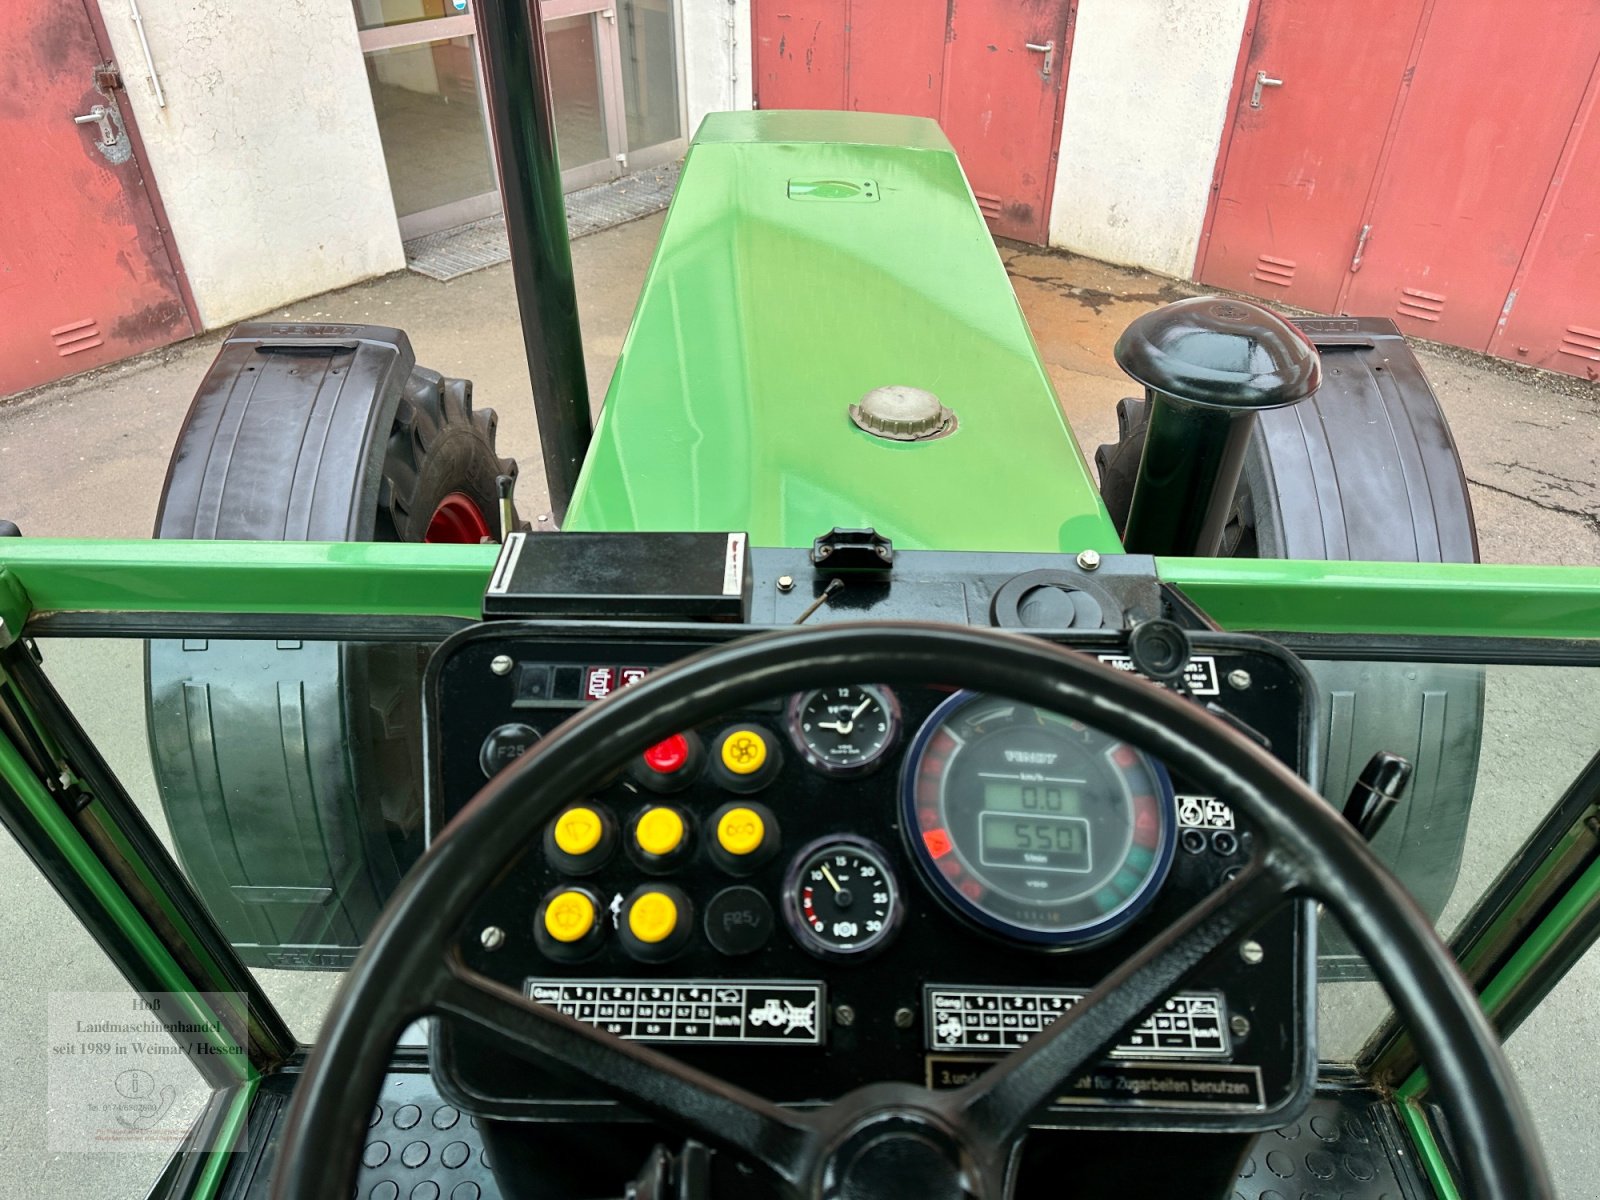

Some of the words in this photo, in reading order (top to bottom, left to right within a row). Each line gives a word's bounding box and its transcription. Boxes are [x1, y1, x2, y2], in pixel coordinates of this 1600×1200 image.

[271, 324, 364, 335] FENDT
[838, 688, 850, 697] 12
[803, 723, 811, 732] 9
[878, 723, 886, 732] 3
[497, 744, 525, 758] F25
[1020, 772, 1044, 781] km/h
[1021, 786, 1062, 811] 0.0
[1015, 824, 1073, 850] 550
[835, 856, 847, 866] 15
[810, 870, 823, 880] 10
[860, 867, 876, 877] 20
[804, 898, 812, 908] 5
[873, 893, 888, 903] 25
[815, 921, 824, 932] 0
[866, 920, 882, 931] 30
[533, 987, 559, 1000] Gang
[576, 987, 583, 997] 1
[613, 988, 622, 998] 2
[652, 988, 661, 998] 3
[690, 988, 699, 998] 4
[936, 996, 961, 1009] Gang
[977, 996, 984, 1006] 1
[1014, 997, 1023, 1007] 2
[1052, 998, 1061, 1008] 3
[715, 1015, 740, 1025] km/h
[1194, 1028, 1219, 1038] km/h
[1094, 1075, 1112, 1090] für
[1115, 1075, 1189, 1094] Zugarbeiten
[1190, 1078, 1250, 1095] benutzen
